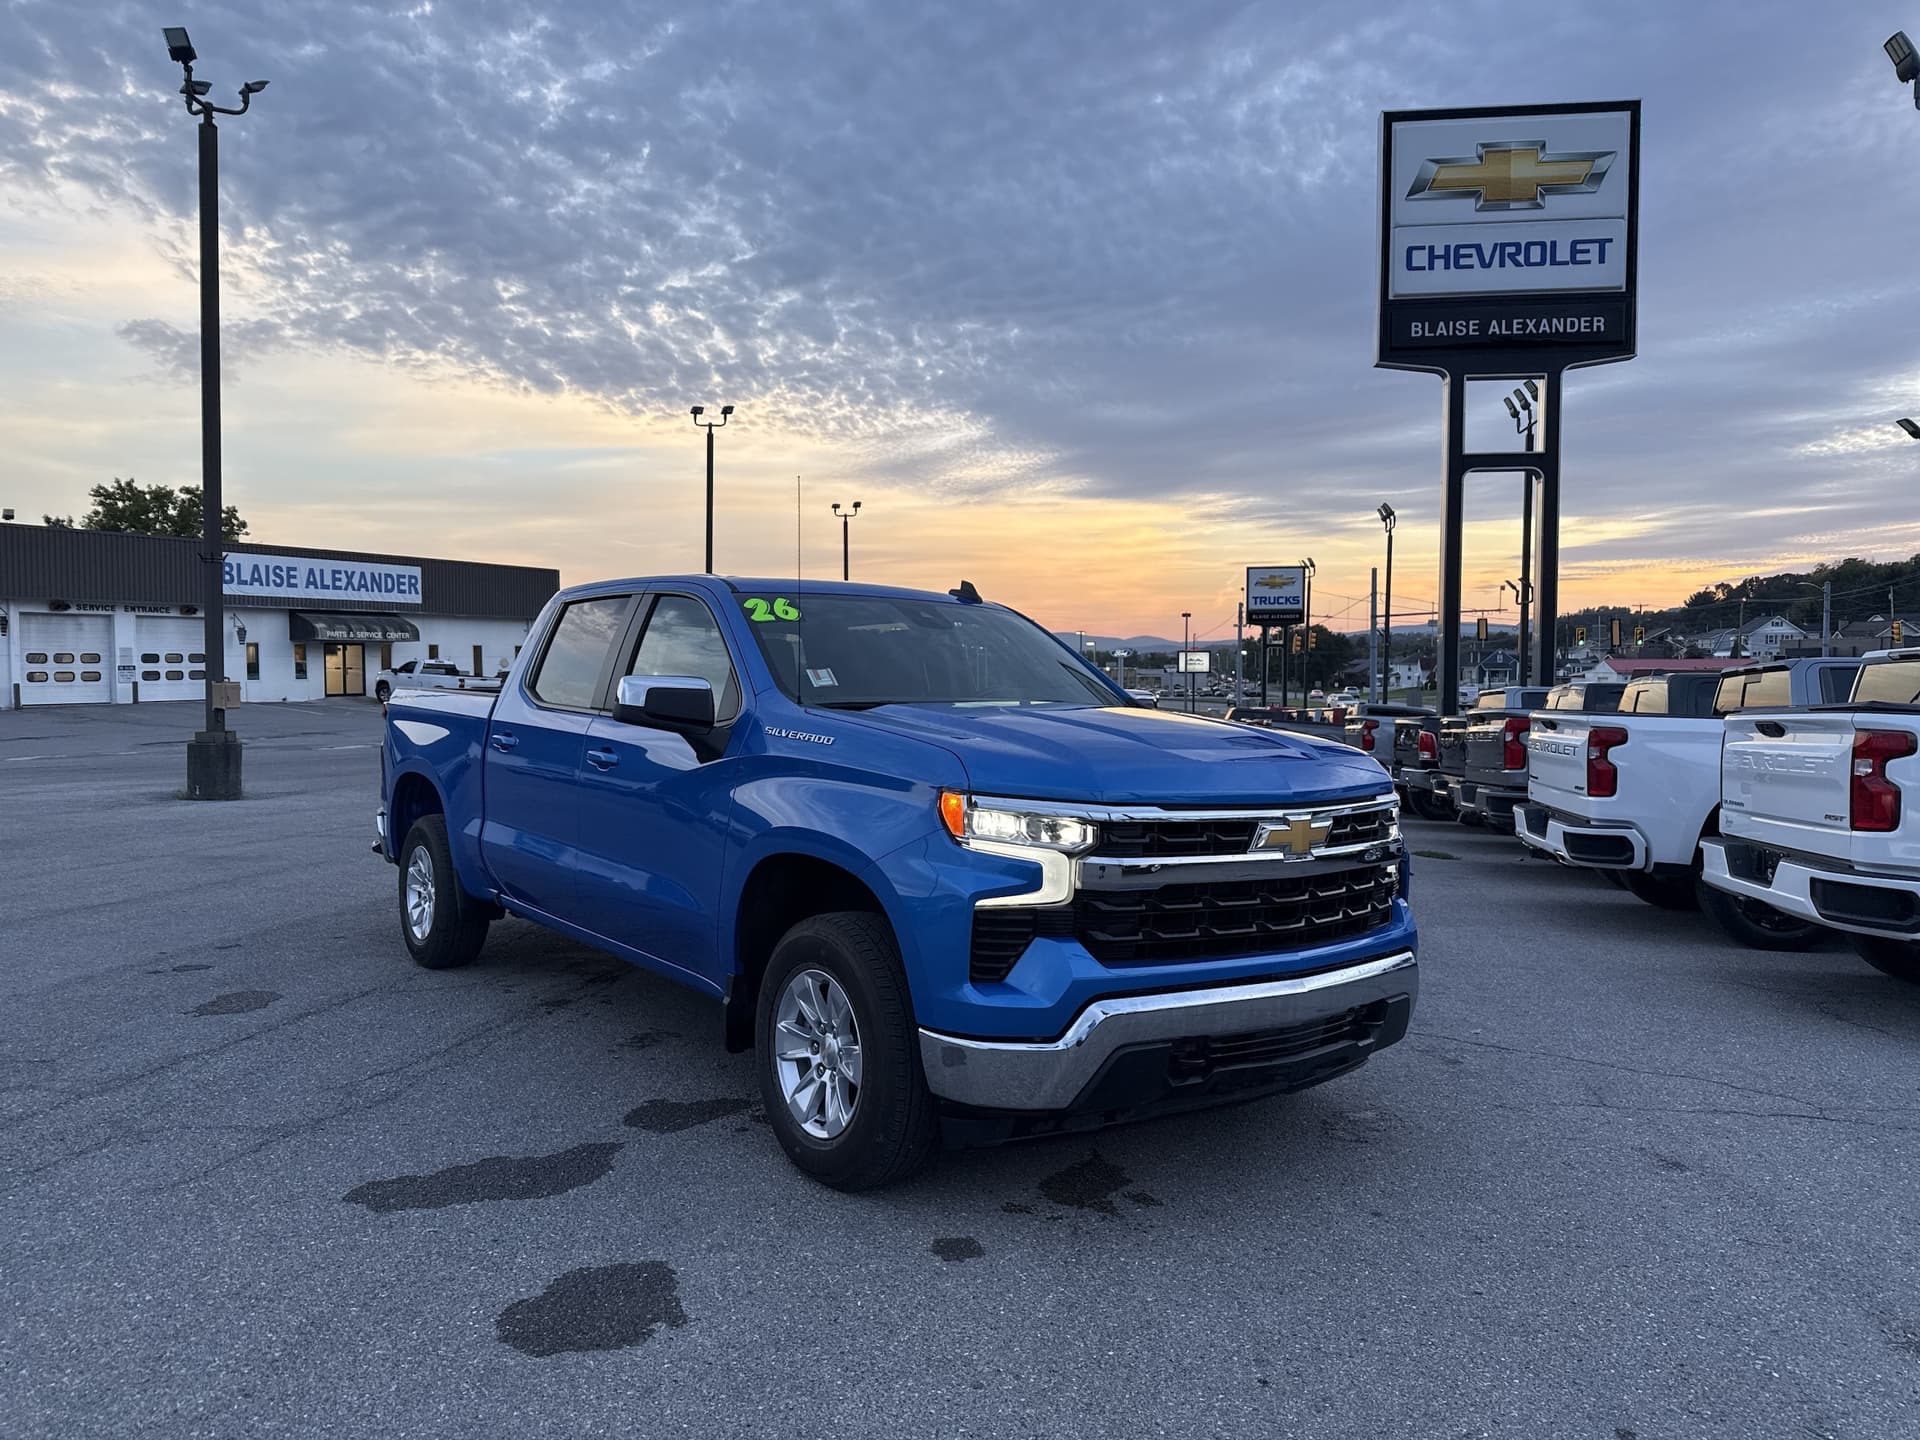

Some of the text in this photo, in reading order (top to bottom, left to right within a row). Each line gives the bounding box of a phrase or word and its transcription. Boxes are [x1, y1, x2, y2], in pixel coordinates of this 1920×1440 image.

[1406, 238, 1613, 271] CHEVROLET
[1411, 316, 1605, 337] BLAISE ALEXANDER
[223, 562, 420, 595] BLAISE ALEXANDER
[76, 604, 172, 614] SERVICE ENTRANCE
[743, 598, 801, 622] 26
[1252, 596, 1301, 605] TRUCKS
[326, 630, 347, 638] PARTS
[356, 631, 383, 639] SERVICE
[764, 726, 835, 745] SILVERADO
[1824, 814, 1847, 822] RST
